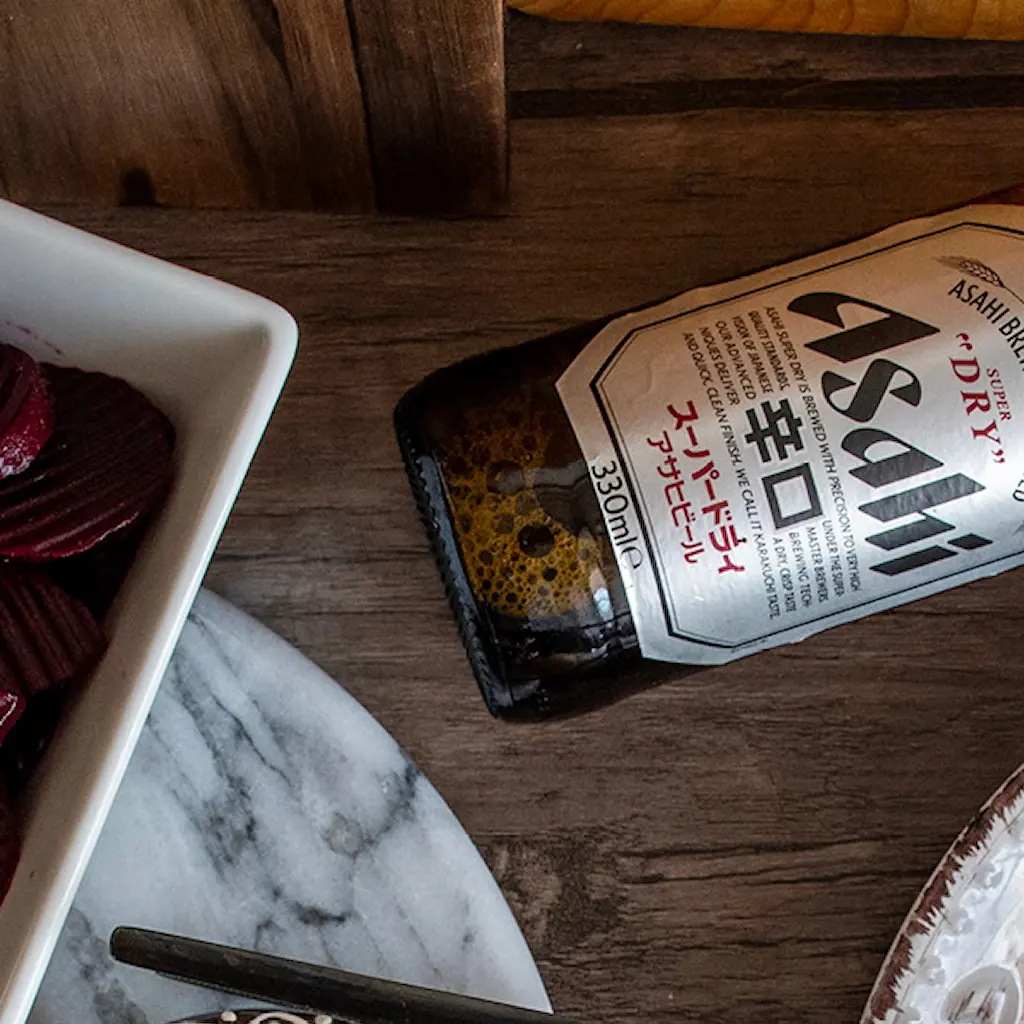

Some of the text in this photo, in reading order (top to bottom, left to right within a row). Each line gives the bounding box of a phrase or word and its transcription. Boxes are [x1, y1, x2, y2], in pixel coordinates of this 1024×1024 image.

[947, 278, 1008, 324] ASAHI
[681, 332, 699, 351] AND
[698, 326, 723, 361] NIQUES
[742, 339, 756, 350] OF
[713, 361, 740, 405] DELIVER
[747, 352, 773, 393] JAPANESE
[705, 386, 728, 422] CLEAN
[985, 368, 1011, 420] SUPER
[714, 320, 732, 341] OUR
[723, 342, 756, 399] ADVANCED
[788, 532, 809, 583] BREWING
[763, 306, 860, 592] ASAHI SUPER DRY IS BREWED WITH PRECISION TO VERY HIGH
[787, 291, 994, 576] Asahi
[735, 468, 750, 486] WE
[744, 397, 822, 530] 辛口
[646, 430, 704, 563] アサヒビール
[665, 399, 744, 573] スーパードライ
[741, 488, 757, 518] CALL
[749, 520, 762, 530] IT
[805, 526, 822, 565] MASTER
[821, 519, 837, 553] UNDER
[830, 554, 840, 571] THE
[753, 533, 776, 594] KARAKUCHI
[779, 567, 793, 591] CRISP
[784, 591, 796, 612] TASTE
